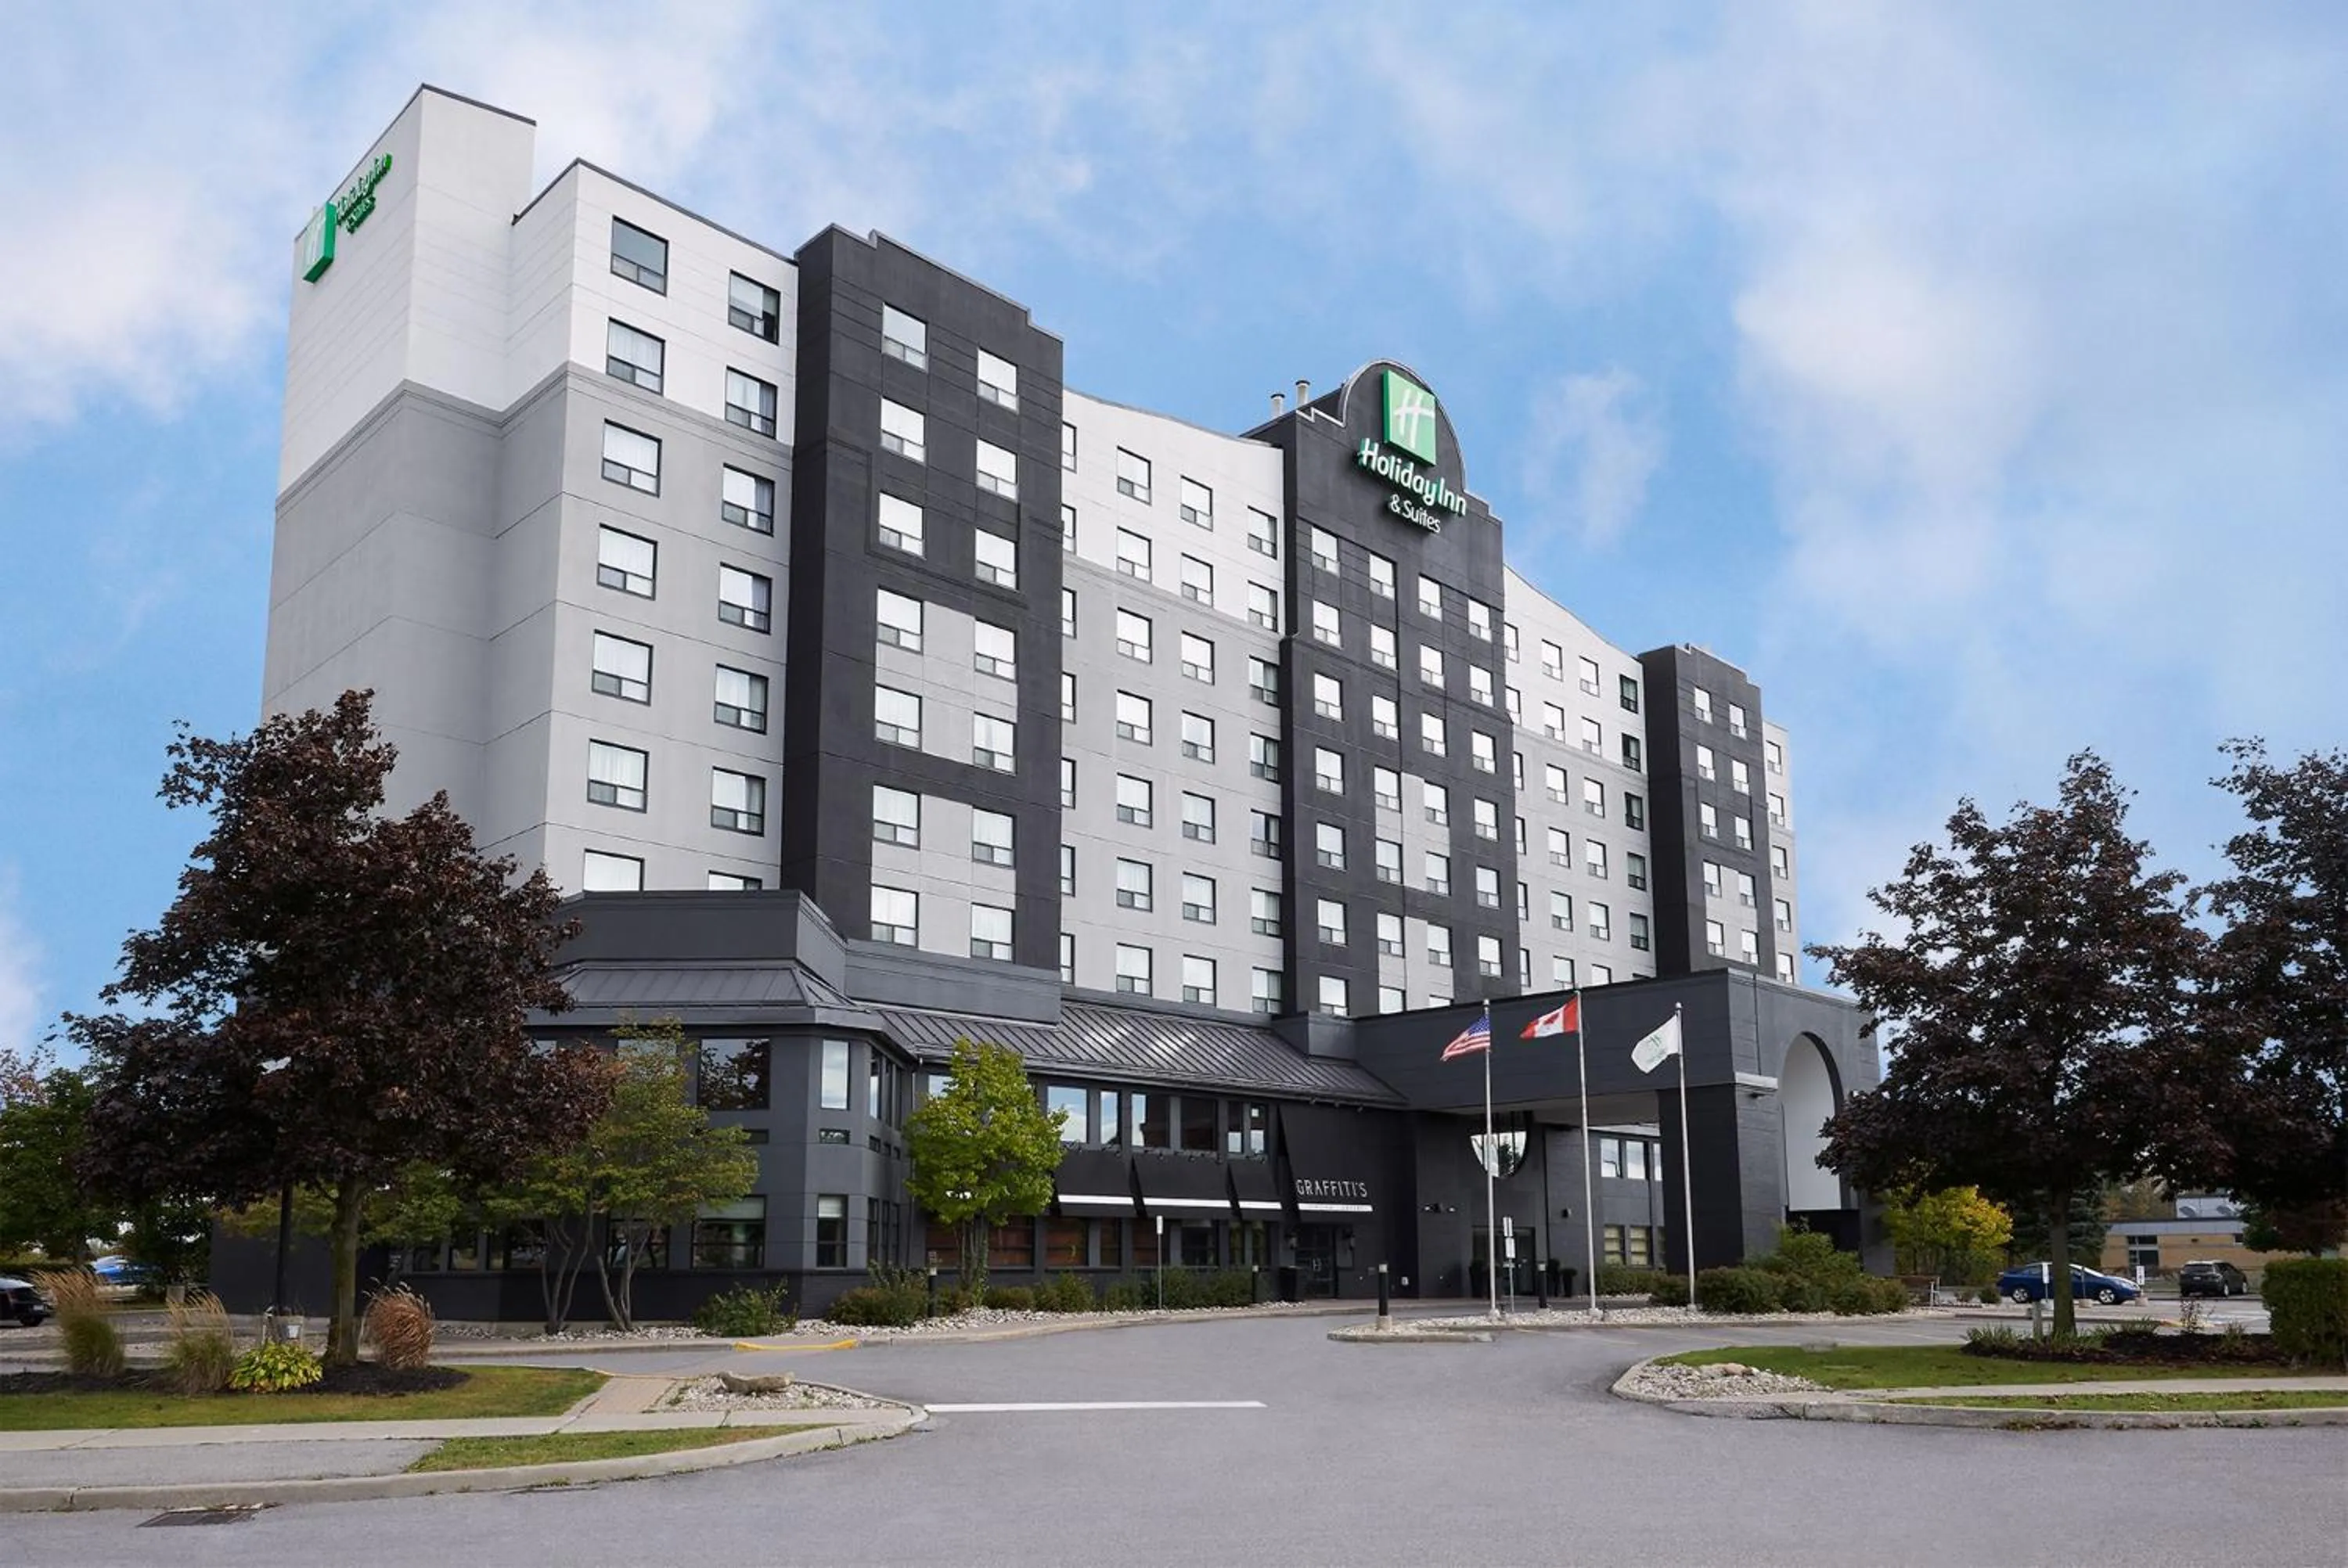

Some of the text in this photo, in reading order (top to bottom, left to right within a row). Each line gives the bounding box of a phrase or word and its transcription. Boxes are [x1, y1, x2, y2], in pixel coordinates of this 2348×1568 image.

[1358, 437, 1467, 516] Holiday Inn
[1389, 494, 1441, 534] & Suites
[1295, 1179, 1368, 1197] GRAFFITI'S
